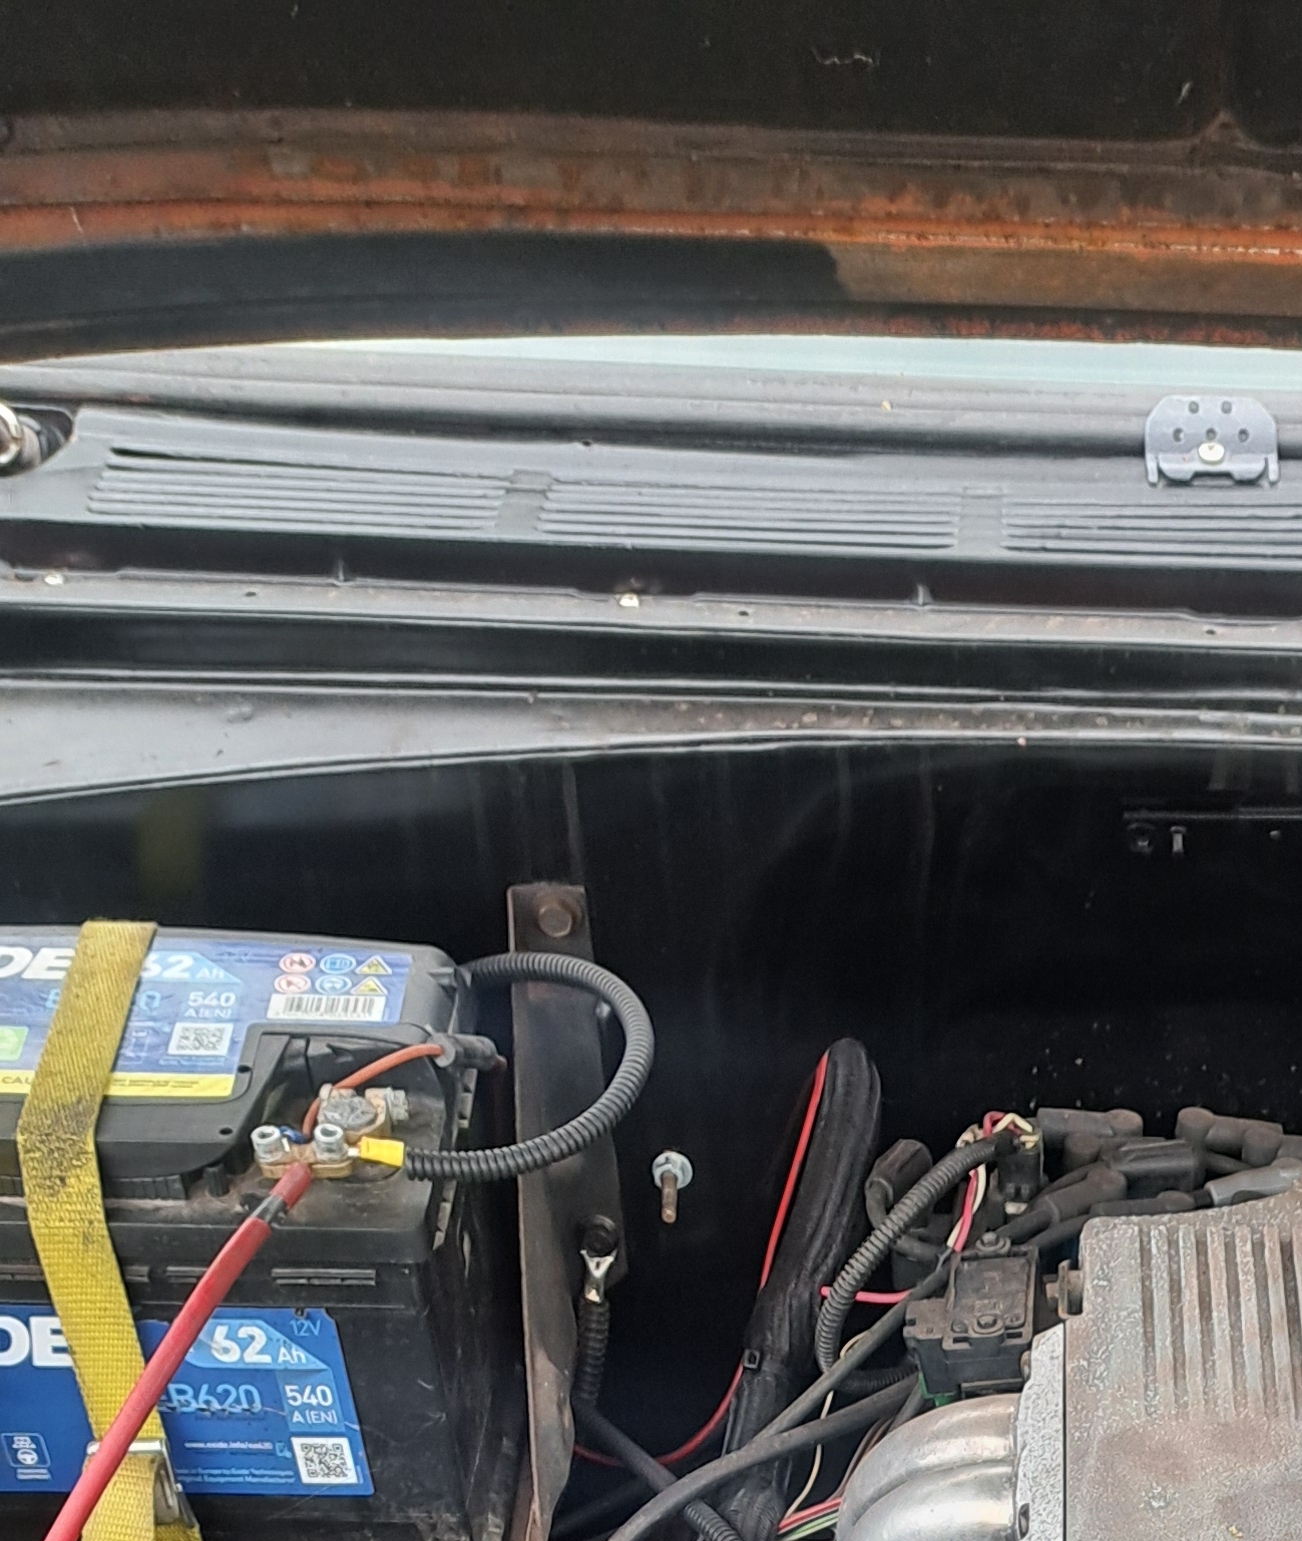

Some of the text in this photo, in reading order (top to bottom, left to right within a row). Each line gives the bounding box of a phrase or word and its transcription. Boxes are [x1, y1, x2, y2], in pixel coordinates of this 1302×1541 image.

[187, 991, 236, 1008] 540
[290, 1319, 321, 1336] 12V
[211, 1325, 306, 1364] 62 Ah
[285, 1385, 333, 1407] 540
